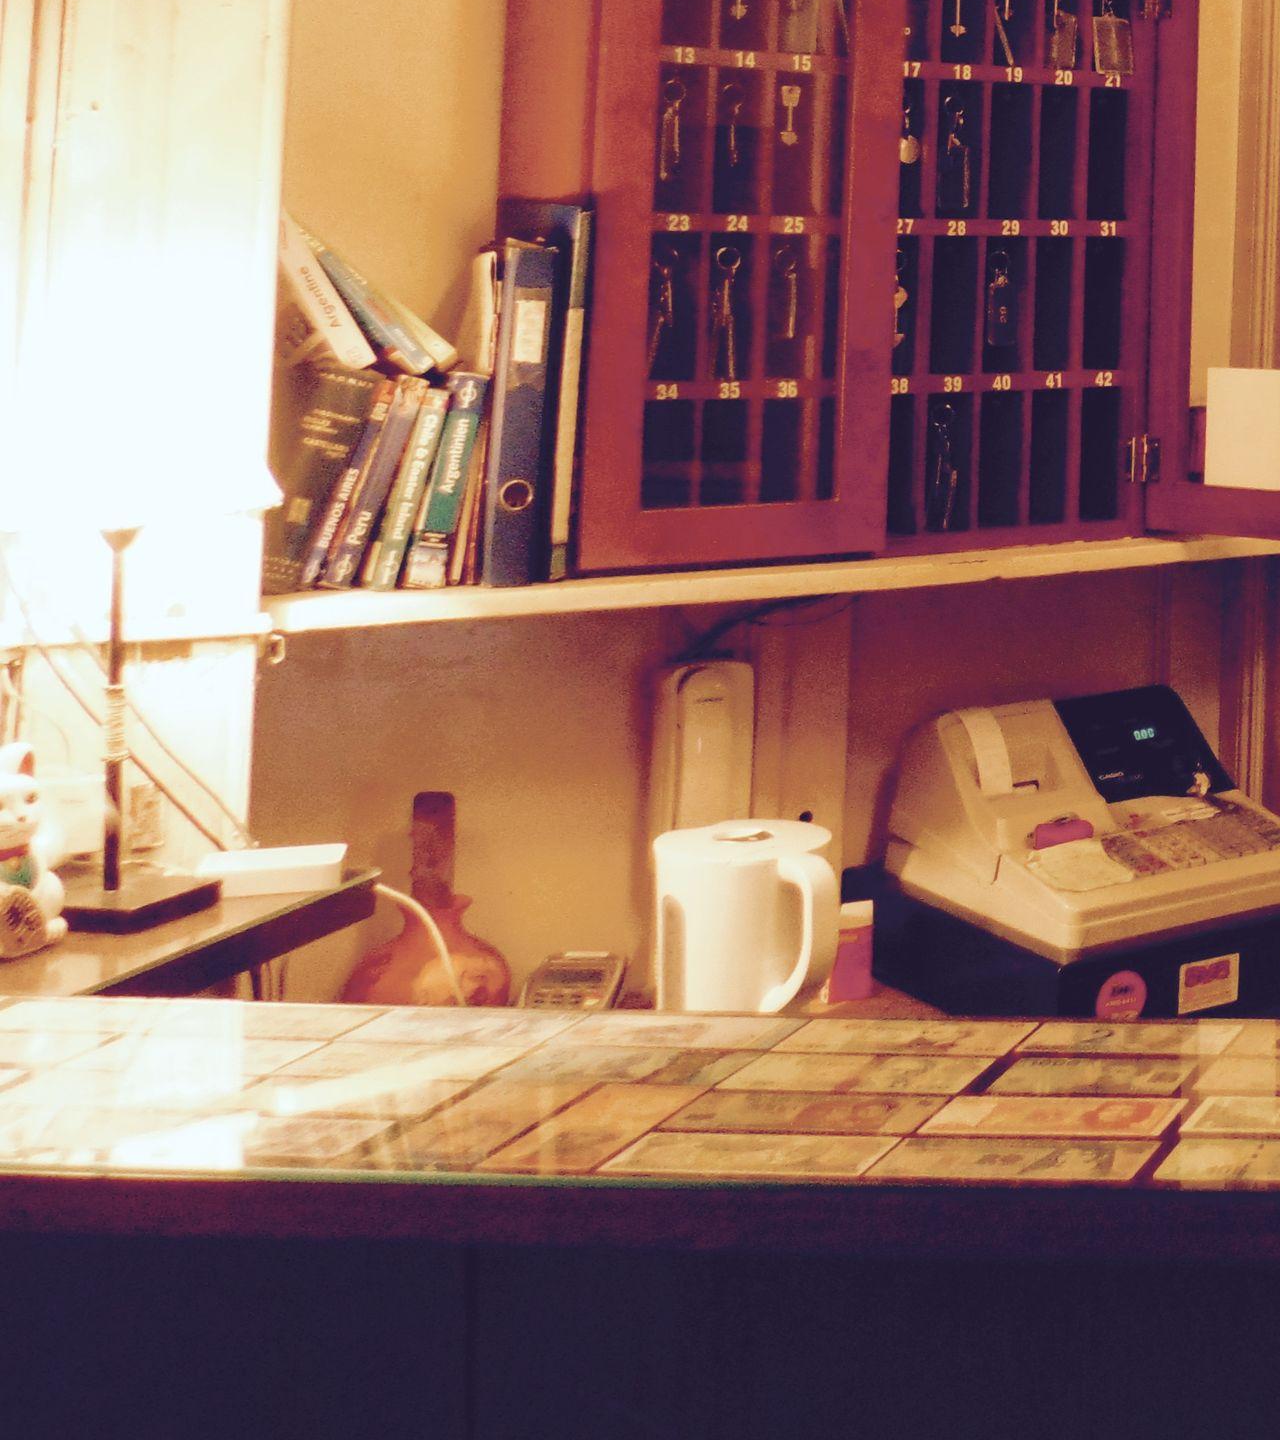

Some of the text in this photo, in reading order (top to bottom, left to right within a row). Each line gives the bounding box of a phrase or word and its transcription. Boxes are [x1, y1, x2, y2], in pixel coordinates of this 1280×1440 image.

[674, 46, 1122, 88] 13 14 15 17 18 19 20 21
[668, 214, 1117, 237] 23 24 25 27 28 29 30 31
[299, 265, 342, 329] Argentine
[656, 370, 1113, 401] 34 35 36 38 39 40 41 42
[443, 417, 470, 495] Argentinien
[319, 500, 346, 547] BUENOS
[349, 510, 374, 546] Peru
